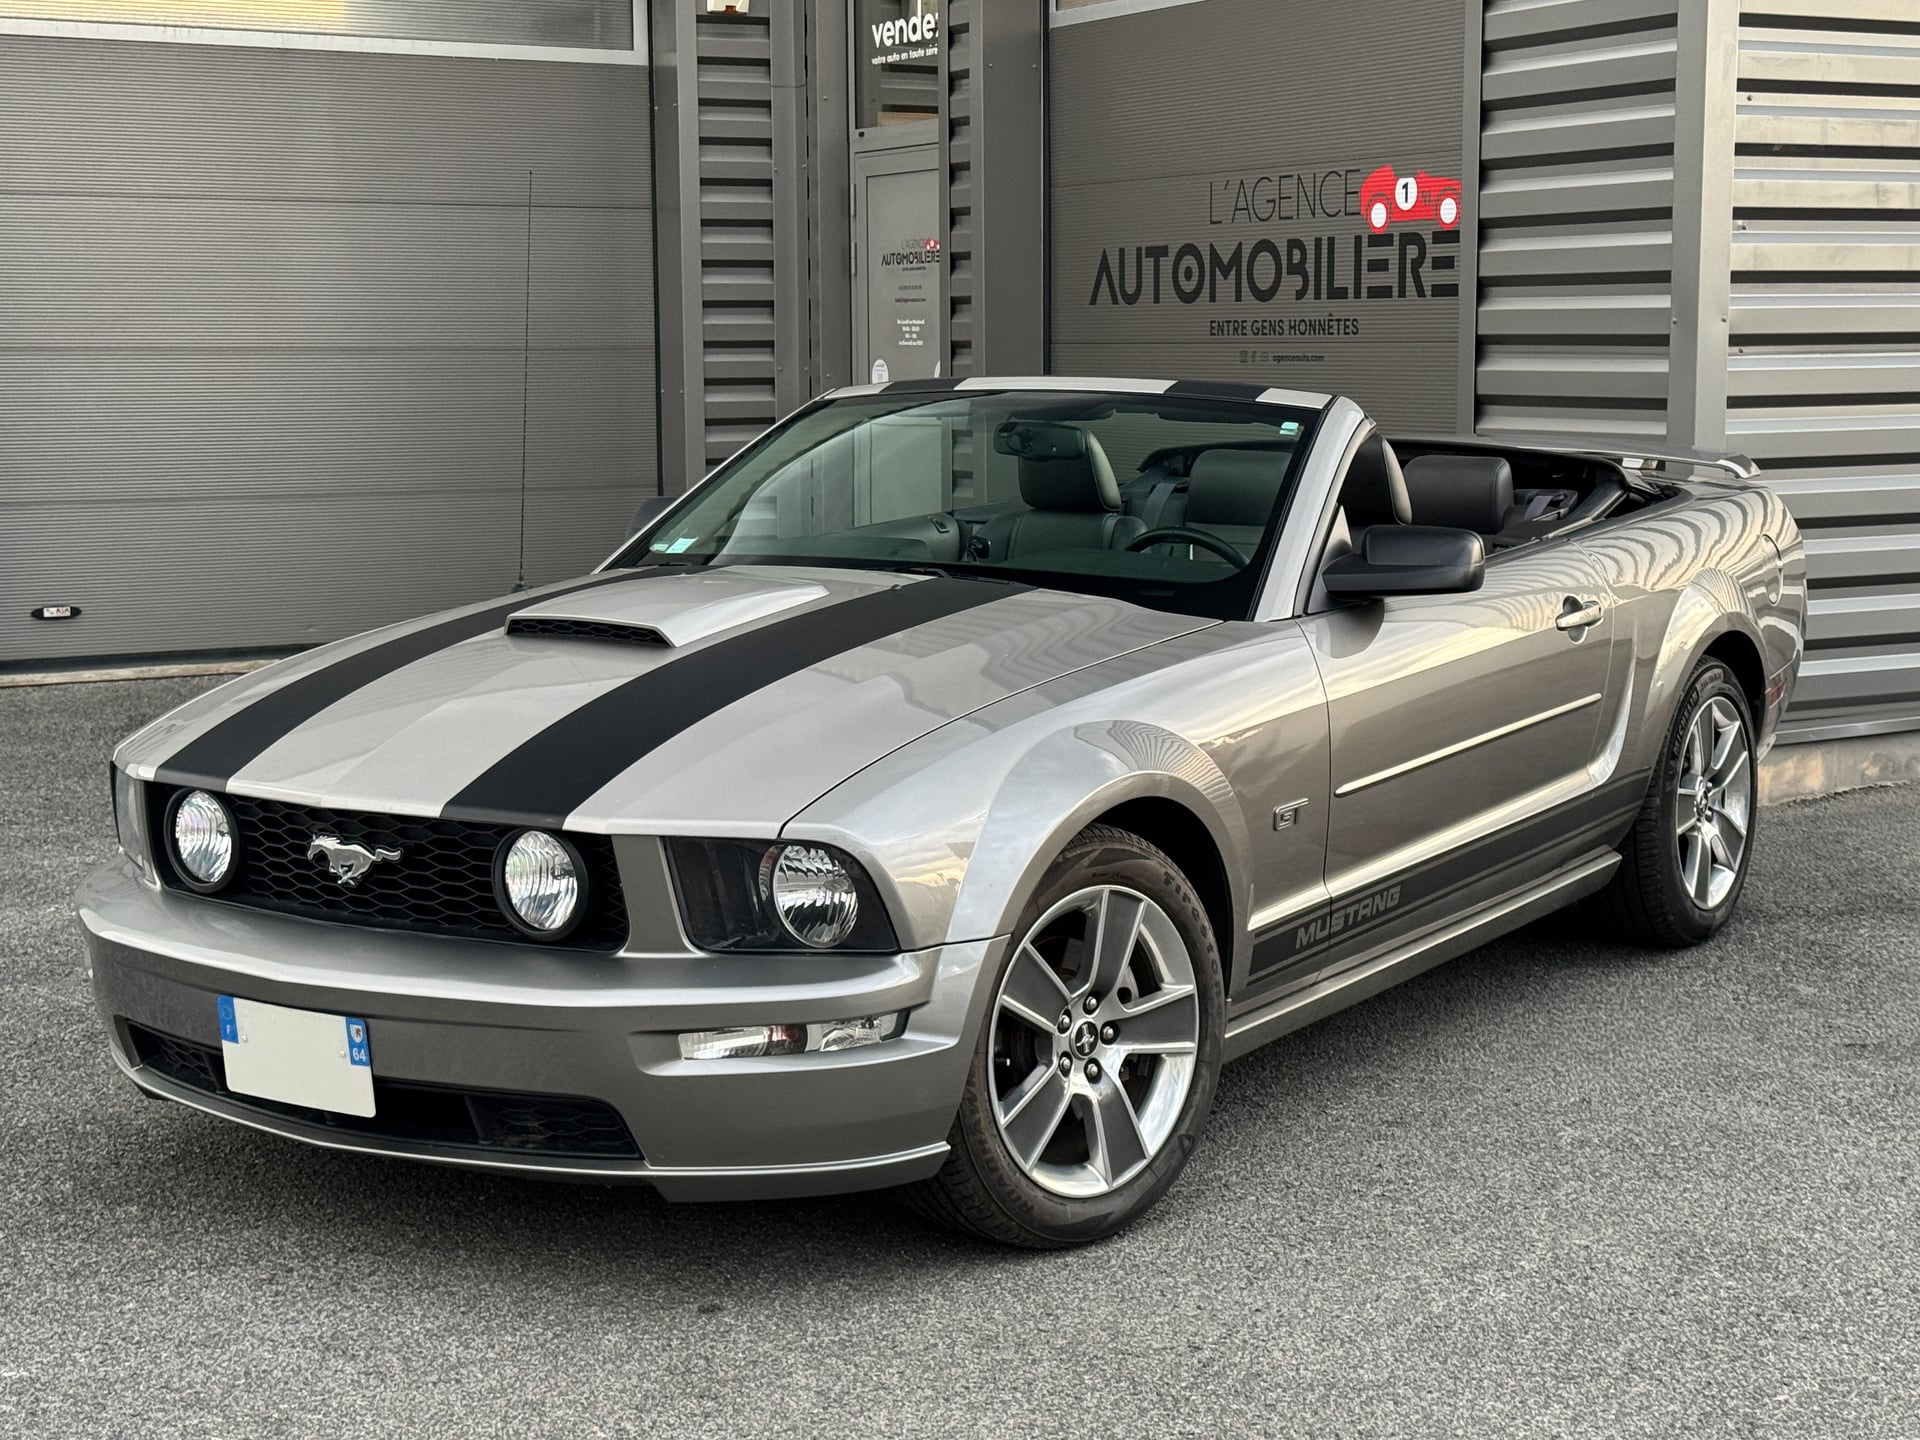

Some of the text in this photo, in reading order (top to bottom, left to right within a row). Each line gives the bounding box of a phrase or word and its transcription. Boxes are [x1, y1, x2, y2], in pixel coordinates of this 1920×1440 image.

[887, 52, 900, 63] auto
[909, 48, 924, 59] toute
[1209, 168, 1361, 225] L'AGENCE
[1401, 182, 1409, 204] 1
[1209, 313, 1360, 337] ENTRE GENS HONNÊTES
[1272, 353, 1325, 364] agenceauto.com
[1673, 690, 1698, 757] MICHELIN
[1273, 798, 1309, 831] GT
[1295, 884, 1401, 949] MUSTANG
[226, 1024, 232, 1035] F
[352, 1047, 366, 1062] 64
